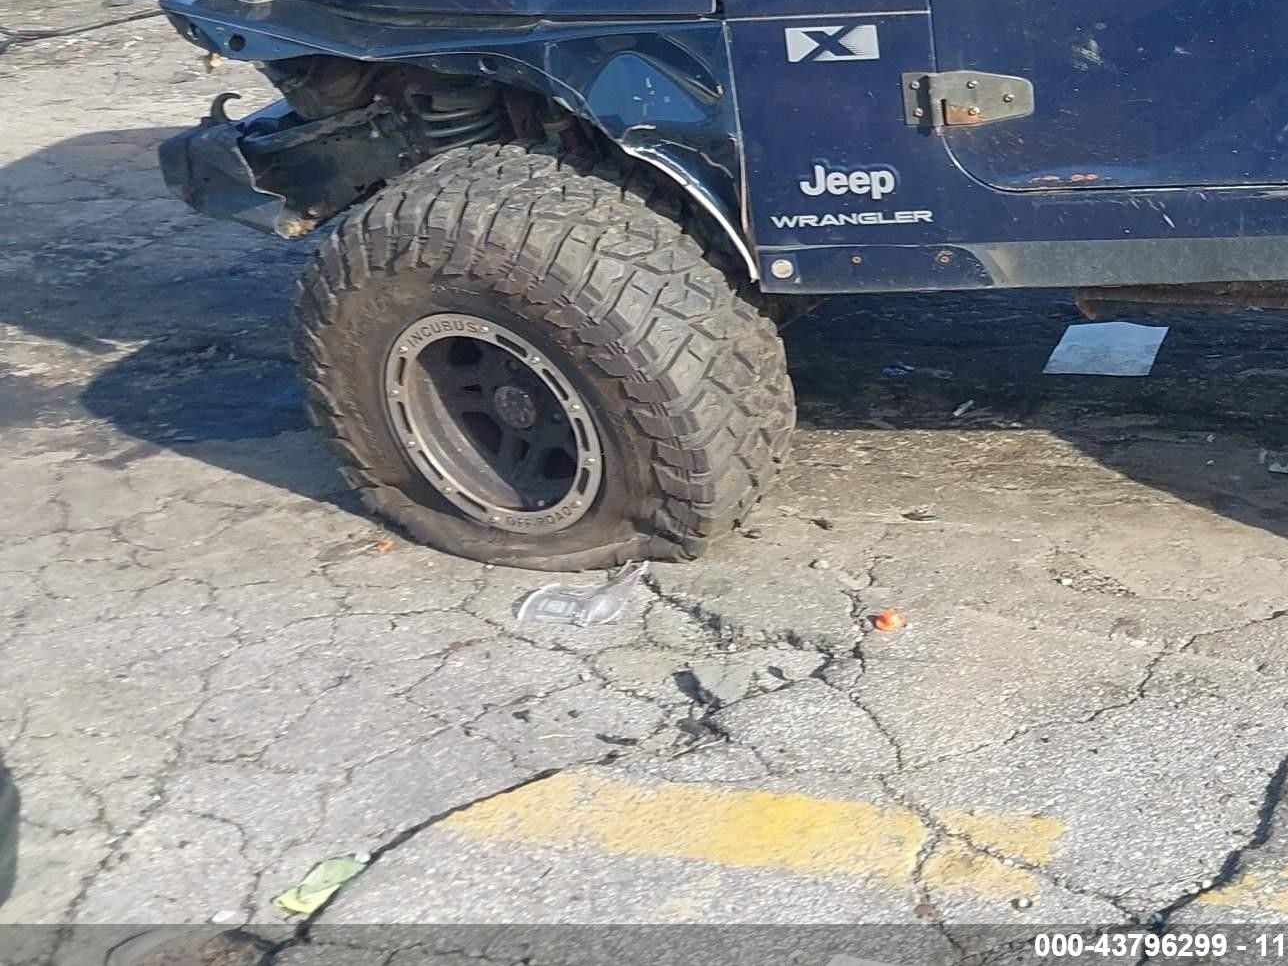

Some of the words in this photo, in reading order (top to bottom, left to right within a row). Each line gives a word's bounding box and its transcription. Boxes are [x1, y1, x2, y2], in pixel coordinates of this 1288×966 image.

[799, 164, 896, 200] Jeep
[770, 209, 934, 229] WRANGLER
[407, 320, 479, 347] INCUBUS
[505, 506, 574, 528] OFF-ROAD
